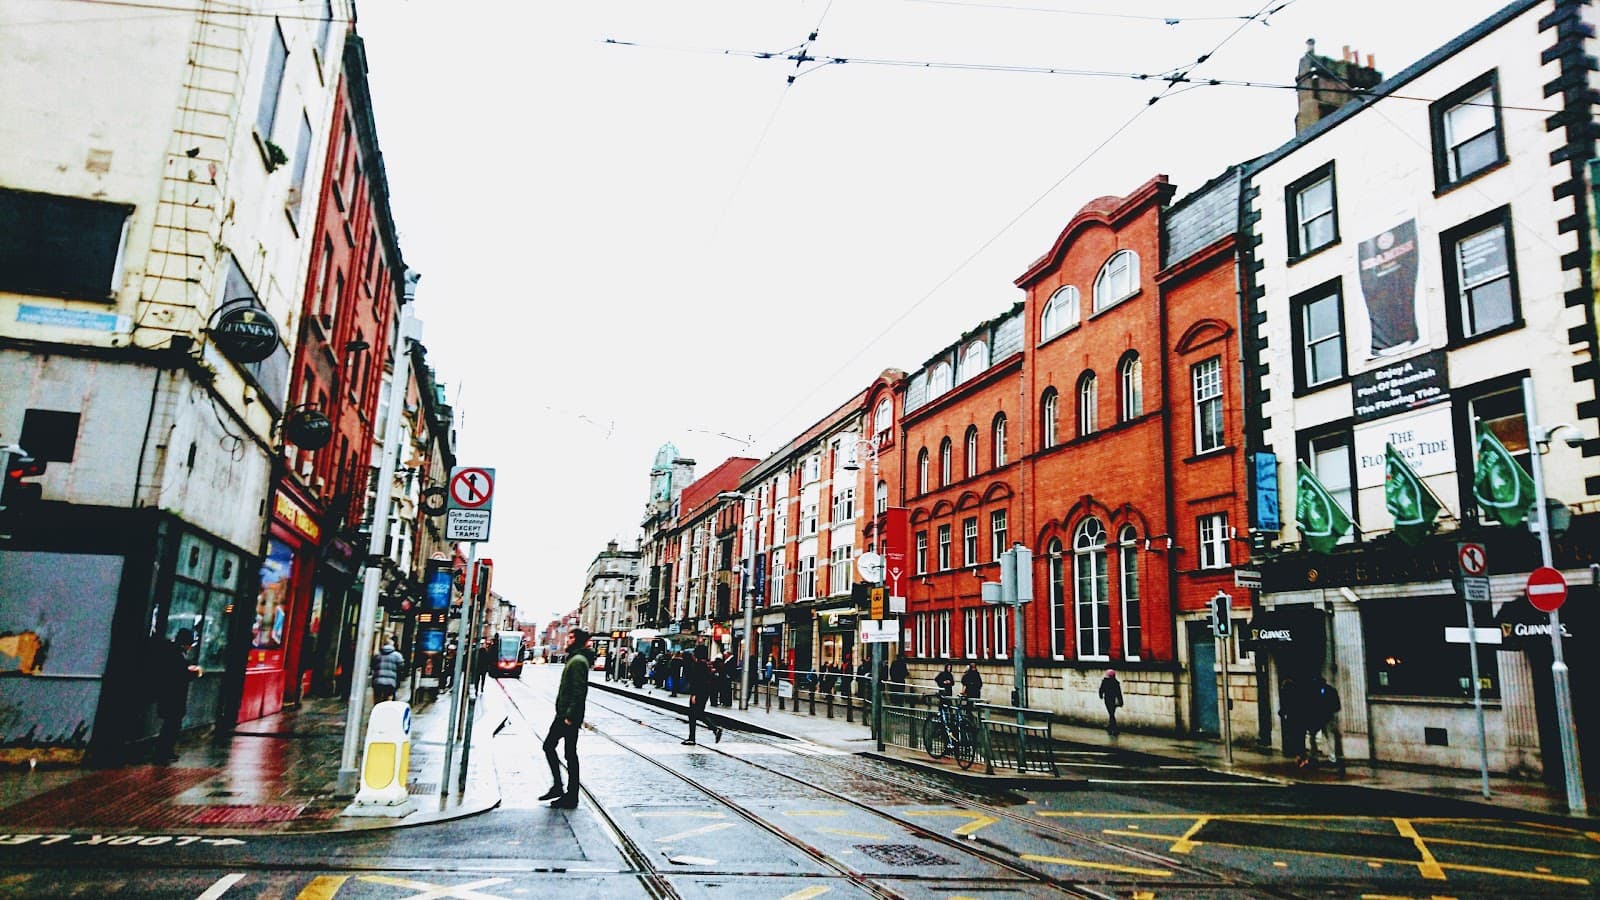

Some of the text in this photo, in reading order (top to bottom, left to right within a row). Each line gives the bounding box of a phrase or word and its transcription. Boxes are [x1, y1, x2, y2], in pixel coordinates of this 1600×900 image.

[1375, 362, 1413, 380] Enjoy A
[1377, 381, 1390, 391] Of
[1390, 367, 1436, 388] Beamish
[1355, 386, 1441, 416] The Flowing Tide
[1389, 430, 1414, 445] THE
[1361, 447, 1415, 468] FLONG
[1418, 439, 1448, 456] TIDE
